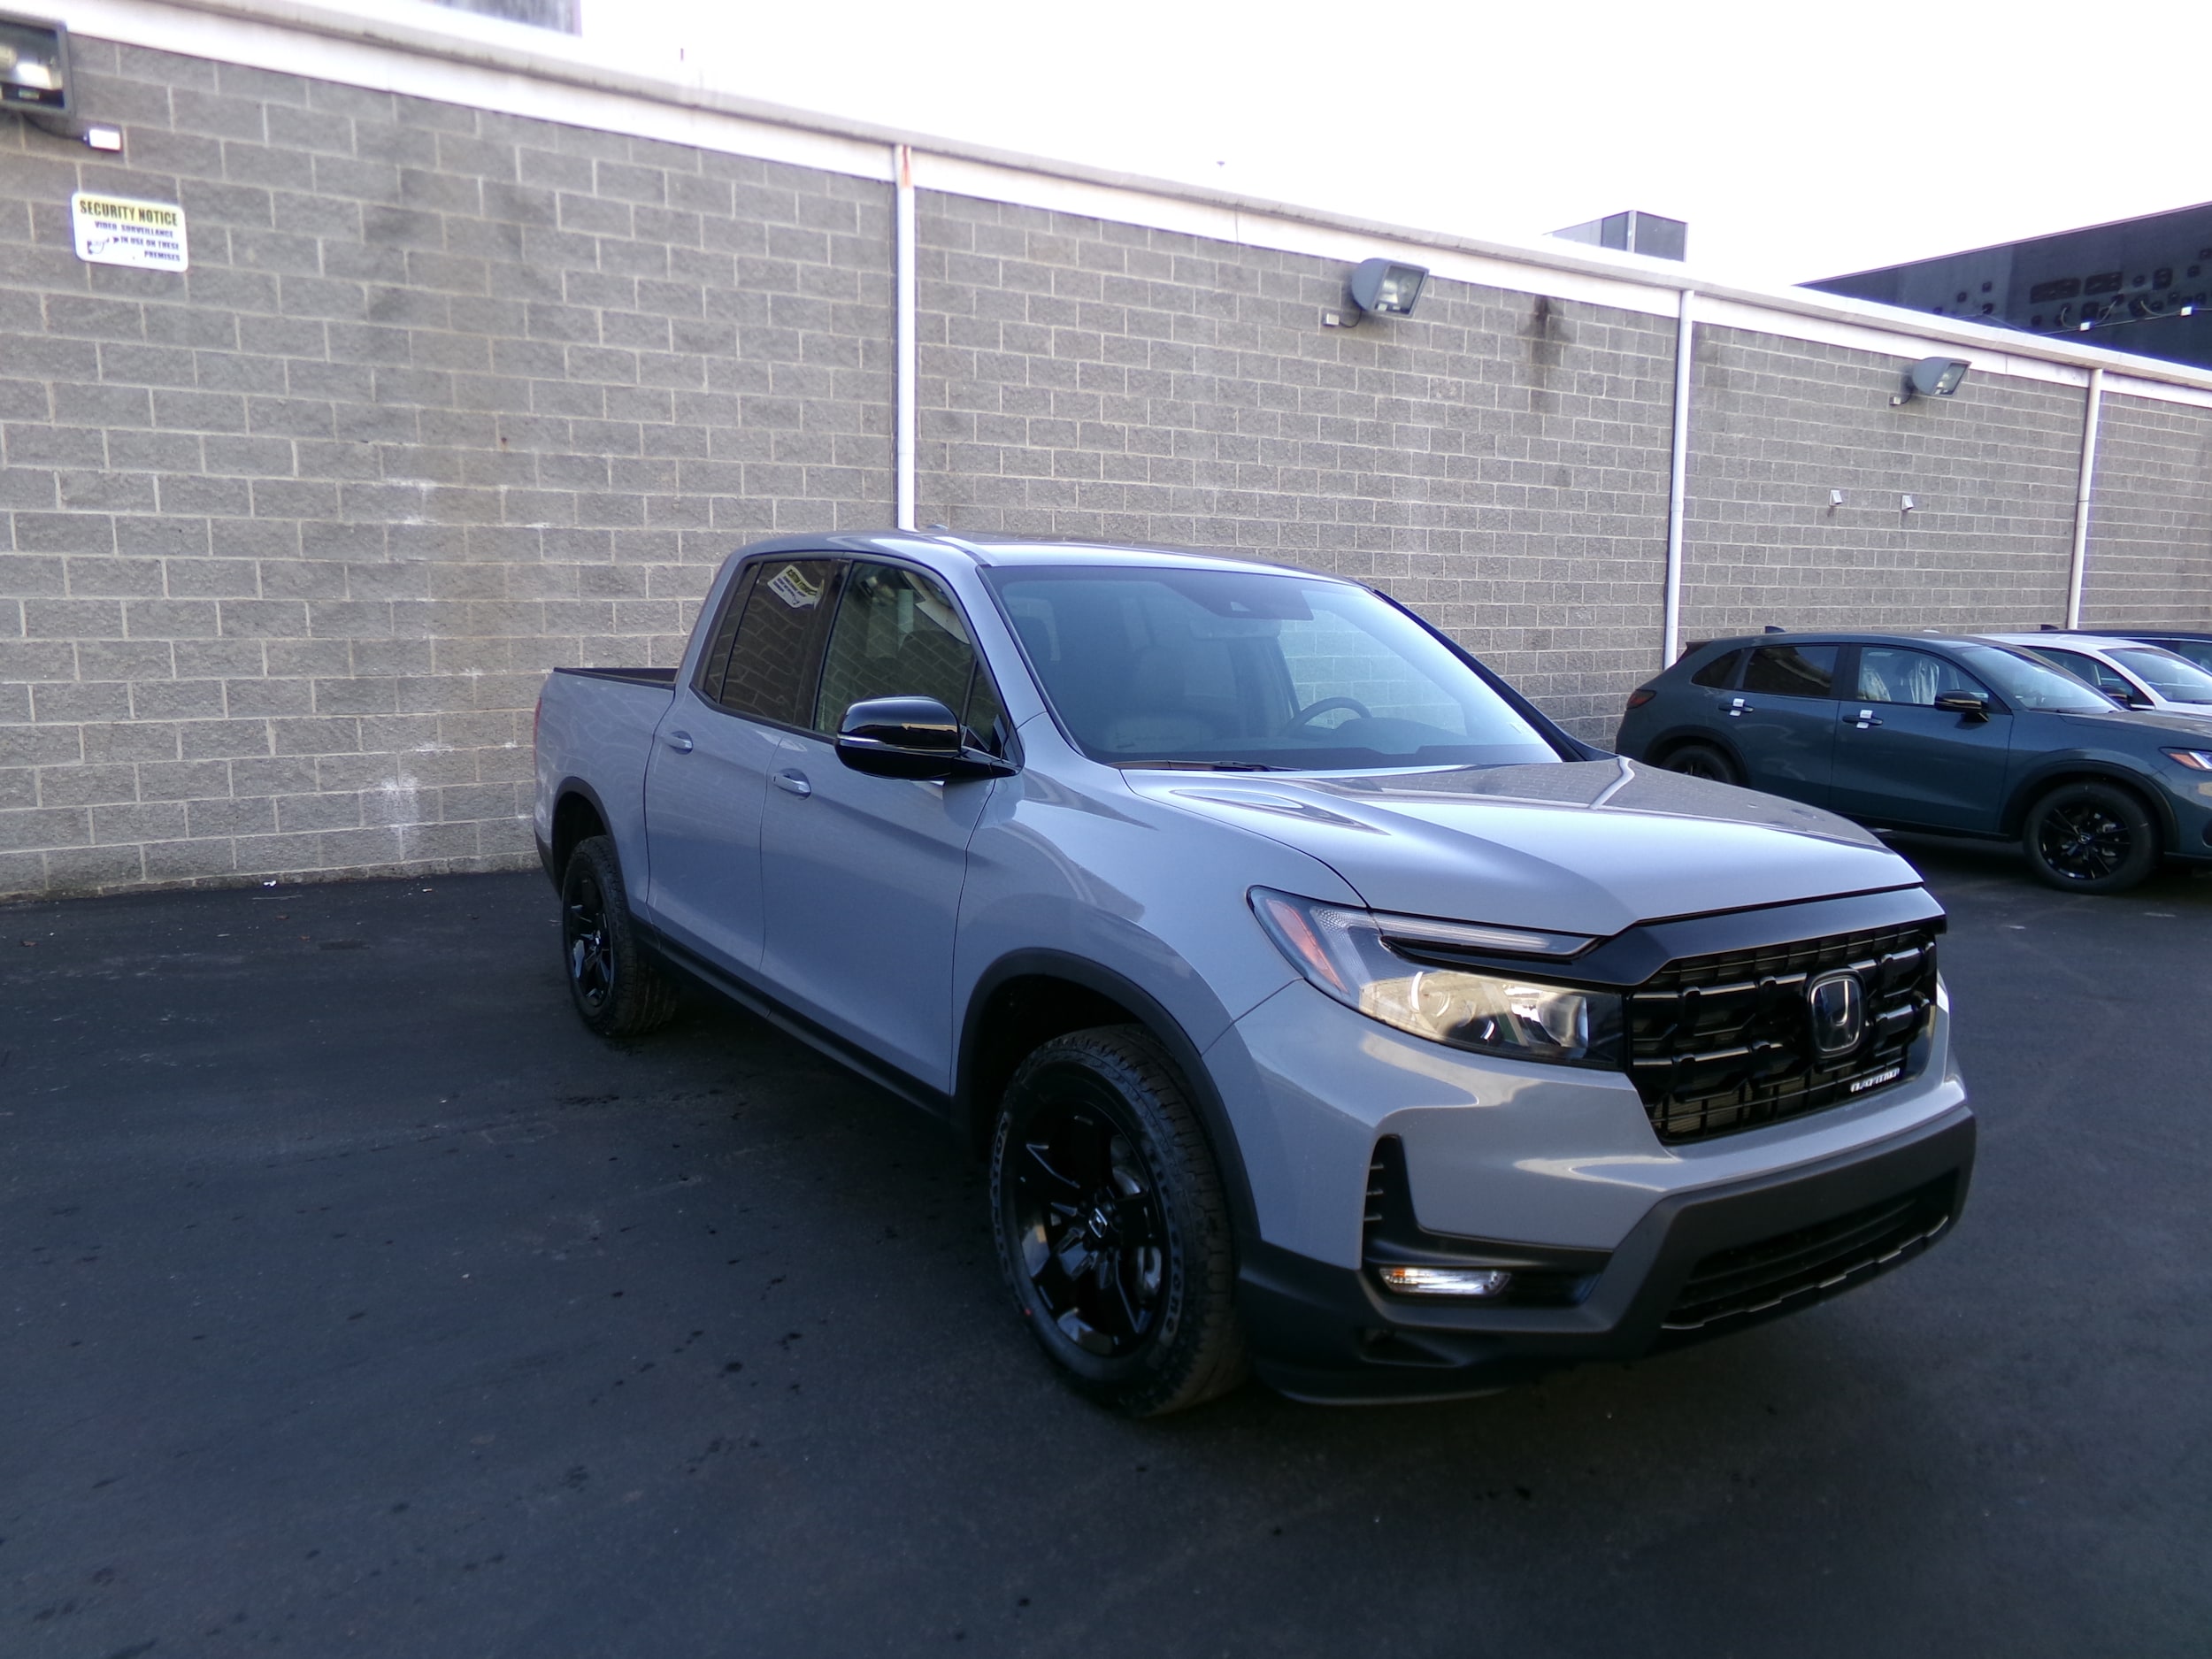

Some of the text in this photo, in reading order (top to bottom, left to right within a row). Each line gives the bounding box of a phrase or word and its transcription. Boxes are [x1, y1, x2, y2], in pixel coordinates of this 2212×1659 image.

[80, 200, 178, 227] SECURITY NOTICE
[95, 221, 173, 238] VIDEO SURVEILLANCE
[130, 236, 144, 246] USE
[158, 240, 179, 250] THESE
[144, 250, 180, 262] PREMISES
